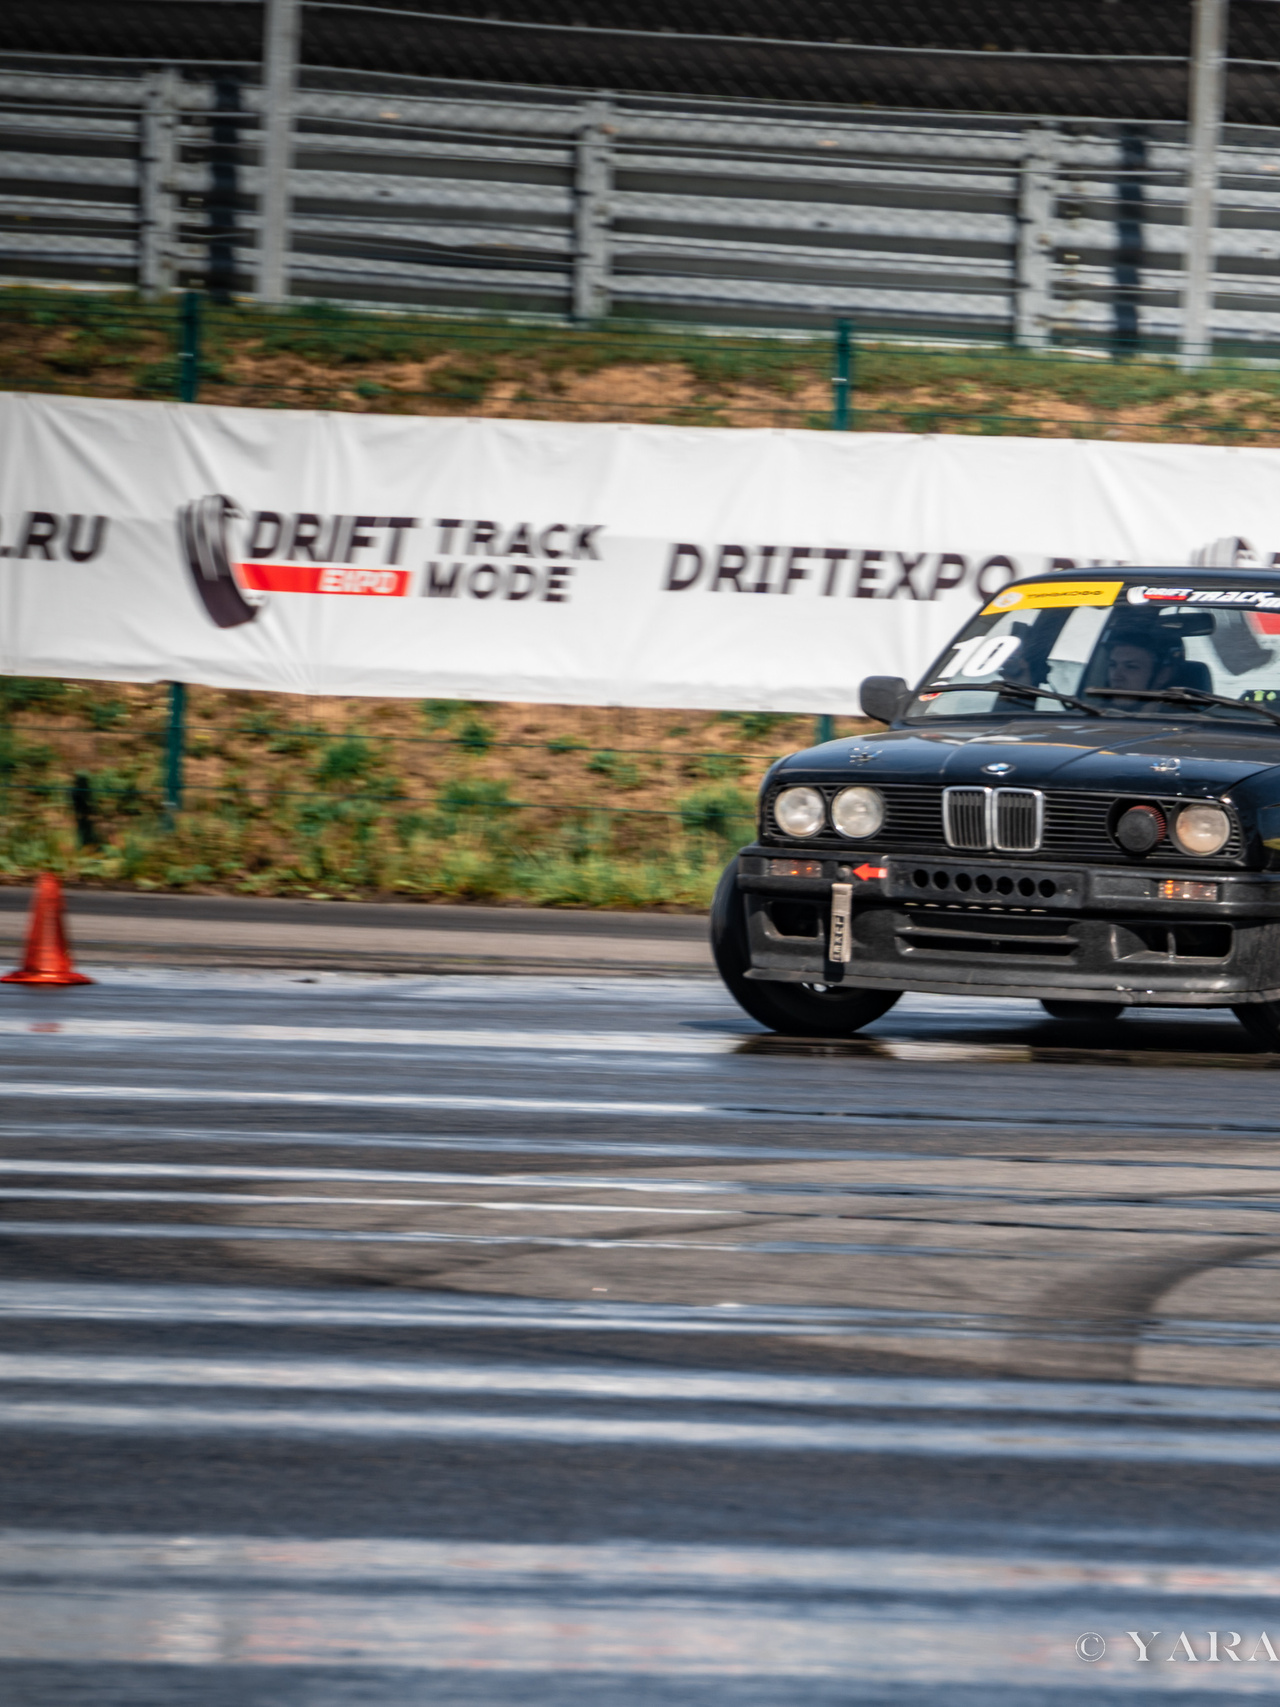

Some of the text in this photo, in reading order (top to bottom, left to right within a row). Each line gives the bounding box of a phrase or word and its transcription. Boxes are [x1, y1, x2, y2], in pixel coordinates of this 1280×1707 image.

[0, 510, 108, 563] .RU
[248, 511, 606, 565] DRIFT TRACK
[319, 568, 399, 594] EXPO
[420, 561, 576, 603] MODE
[662, 542, 1130, 603] DRIFTEXPO
[1146, 587, 1194, 597] DRIFT
[1187, 591, 1274, 602] TRACK
[937, 635, 1022, 679] 10
